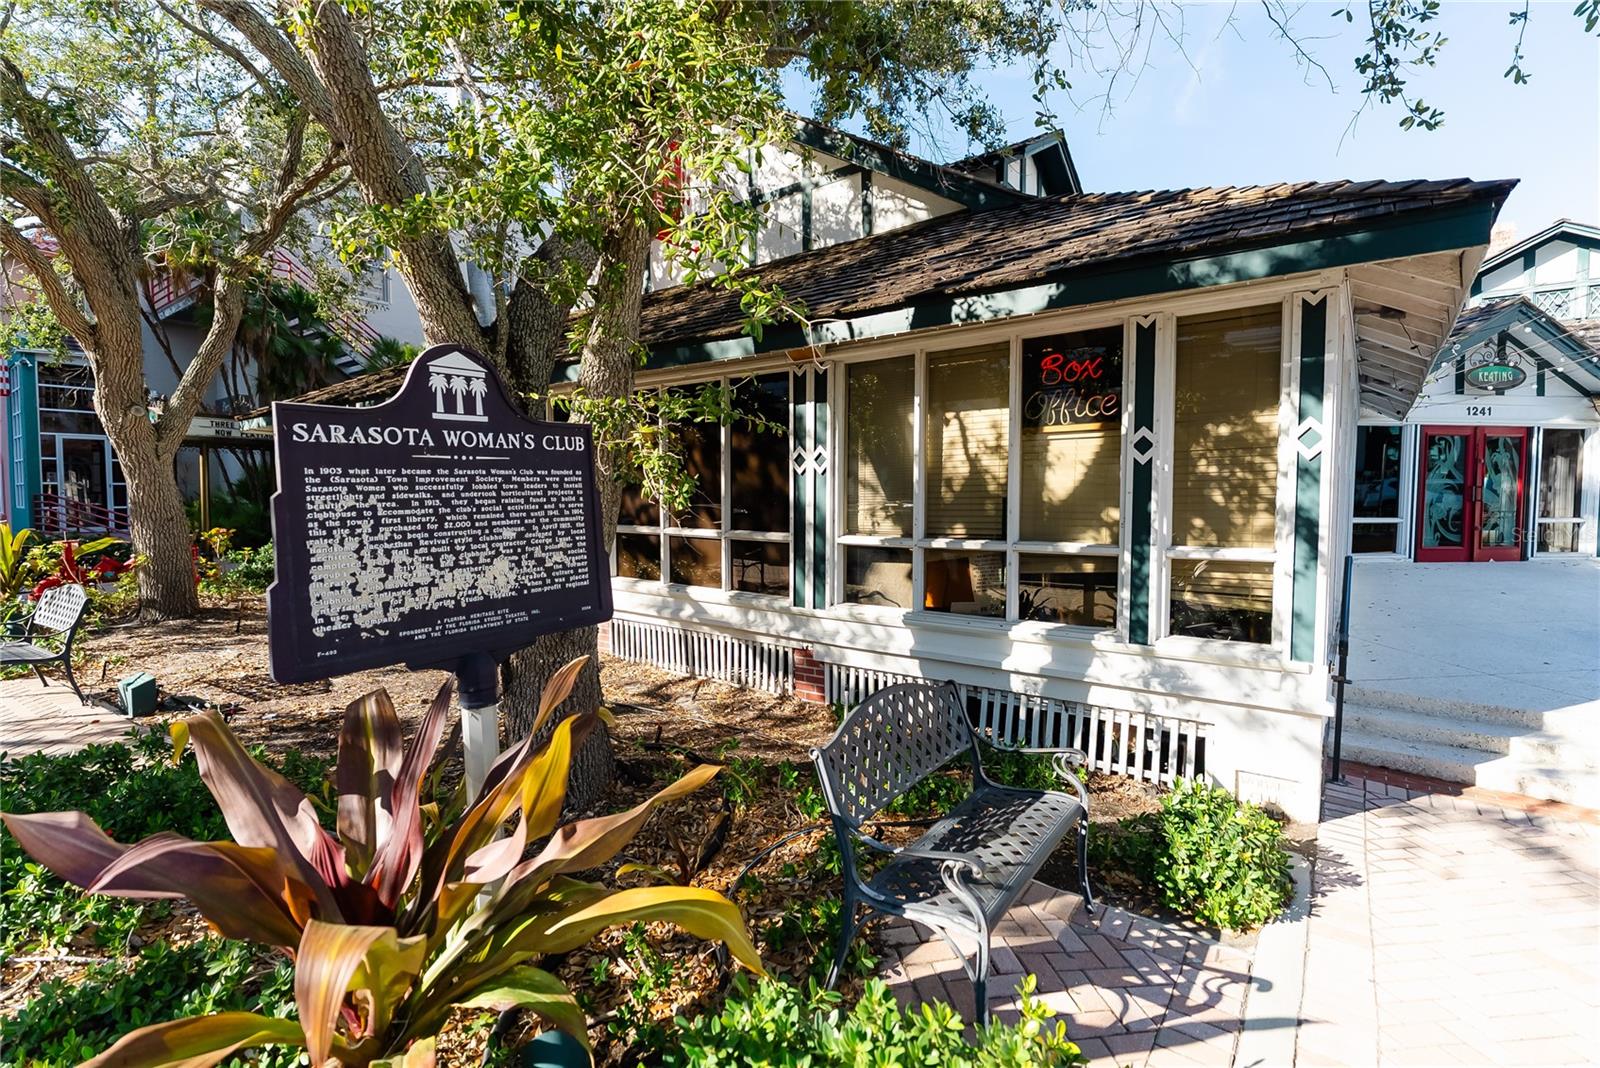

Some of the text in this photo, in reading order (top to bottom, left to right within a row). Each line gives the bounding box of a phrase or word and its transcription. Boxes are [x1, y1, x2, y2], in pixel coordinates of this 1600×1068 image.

[1041, 354, 1103, 385] Box
[1478, 371, 1513, 382] KEATING
[1025, 388, 1118, 425] Office
[1466, 406, 1492, 416] 1241
[210, 420, 234, 429] THREE
[215, 429, 232, 437] NOW
[292, 423, 585, 451] SARASOTA WOMAN'S CLUB
[304, 467, 314, 475] In
[320, 467, 342, 475] 1903
[330, 476, 378, 484] (Sarasota)
[415, 476, 468, 484] Improvement
[406, 532, 429, 540] begin
[434, 528, 481, 538] constructing
